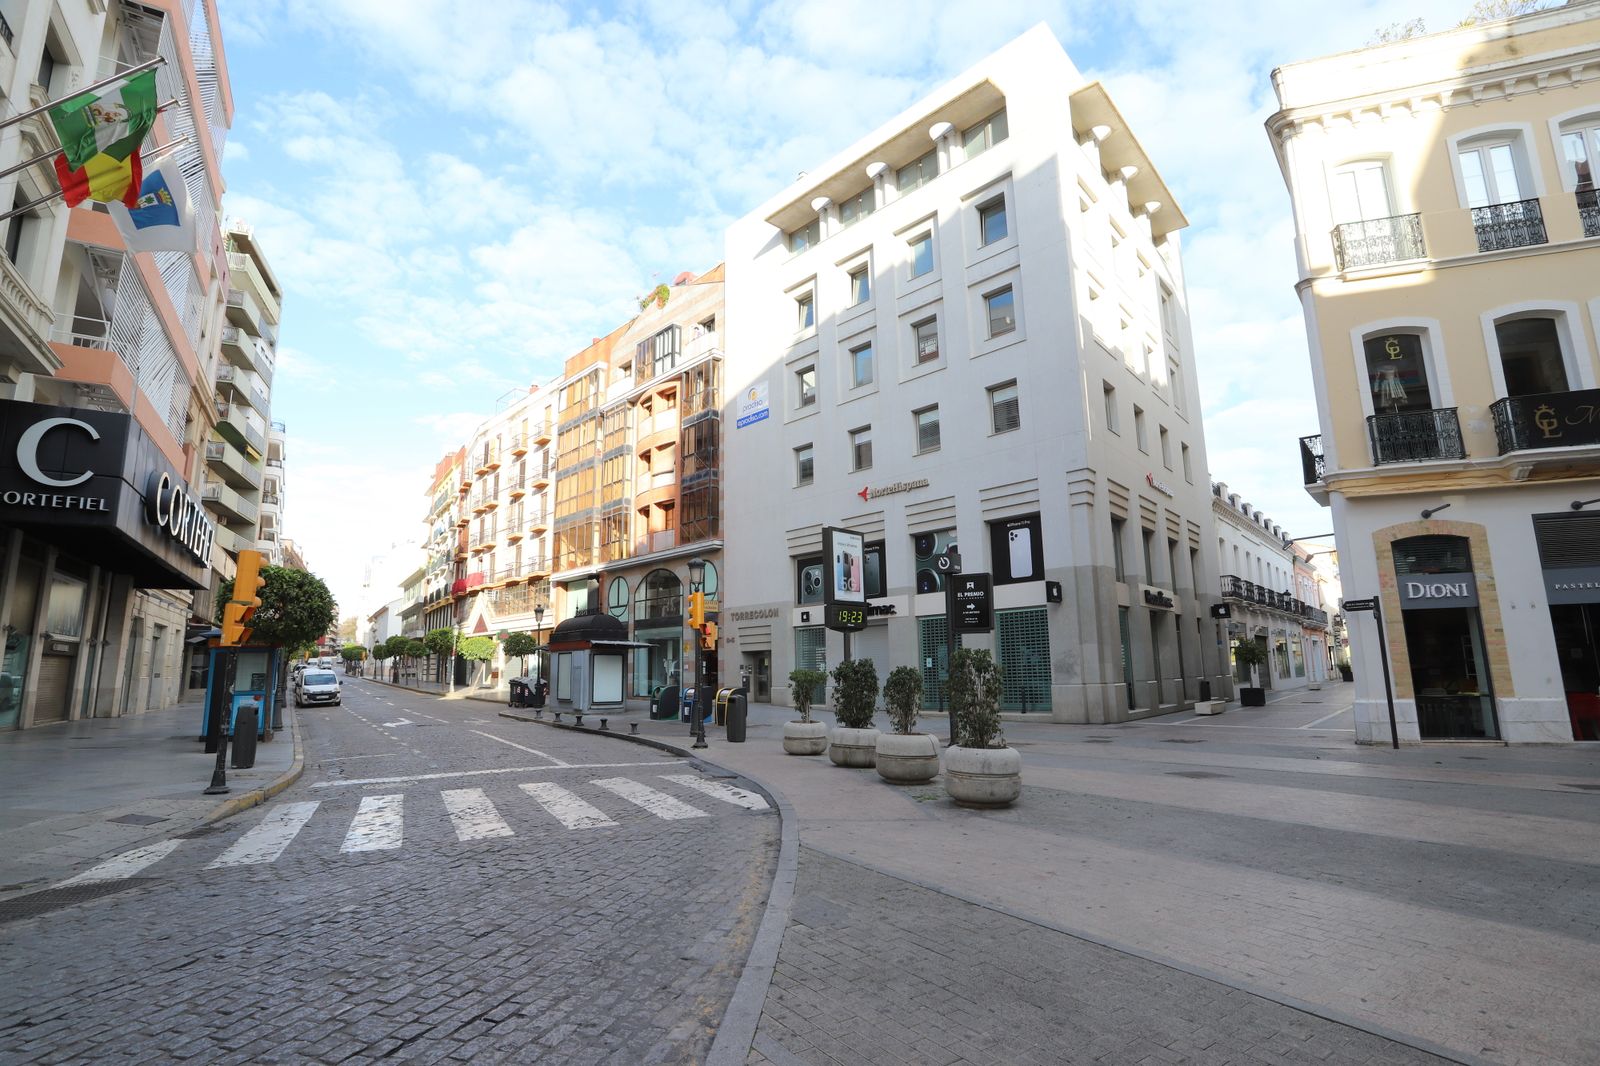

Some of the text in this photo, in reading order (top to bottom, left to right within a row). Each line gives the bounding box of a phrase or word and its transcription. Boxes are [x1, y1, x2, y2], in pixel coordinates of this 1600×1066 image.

[0, 490, 110, 512] ORTEFIEL
[154, 471, 214, 569] CORTEFIEL
[1407, 582, 1471, 599] DIONI
[838, 610, 863, 623] 19:23
